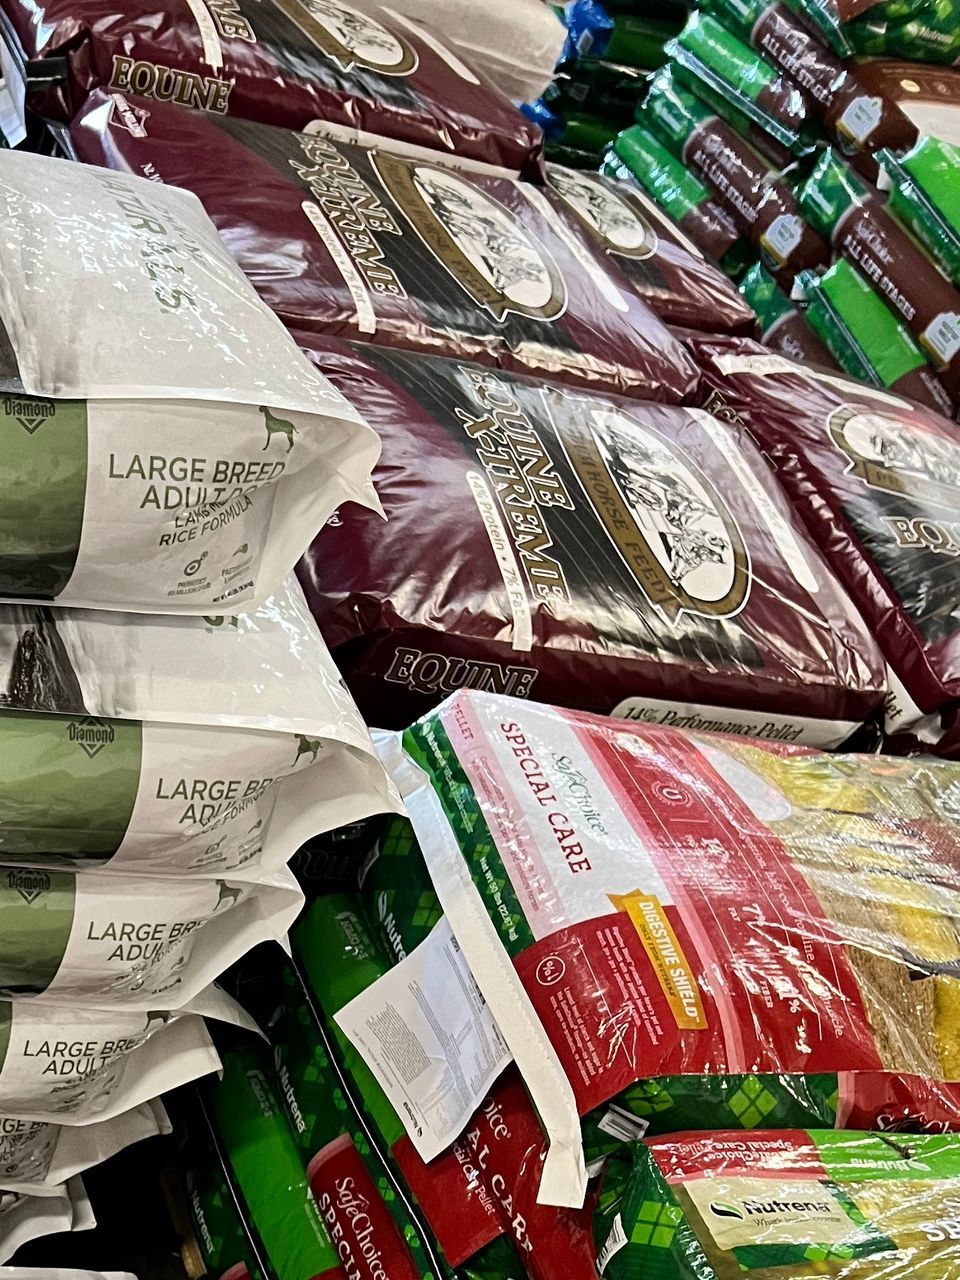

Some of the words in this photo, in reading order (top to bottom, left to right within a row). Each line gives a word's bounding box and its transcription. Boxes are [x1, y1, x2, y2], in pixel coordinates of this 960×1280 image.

[109, 54, 232, 115] EQUINE
[292, 131, 403, 235] EQUINE
[843, 236, 863, 261] ALL
[857, 252, 883, 284] LIFE
[880, 277, 916, 322] STAGES
[1, 397, 56, 419] Diamond
[458, 365, 575, 511] EQUINE
[109, 454, 207, 483] LARGE
[212, 460, 286, 484] BREED
[159, 527, 197, 547] RICE
[201, 494, 253, 536] FORMULA
[590, 475, 628, 530] HORSE
[626, 541, 670, 597] FEED
[484, 502, 505, 551] Protein
[513, 592, 525, 617] Fat
[388, 648, 539, 701] EQUINE
[67, 723, 114, 743] Diamond
[452, 703, 473, 741] PELLET
[660, 710, 756, 737] Performance
[757, 721, 804, 742] Pellet
[156, 778, 240, 801] LARGE
[501, 721, 557, 807] SPECIAL
[548, 812, 592, 873] CARE
[552, 752, 608, 835] SafeChoice
[7, 872, 51, 892] Diamond
[87, 921, 167, 942] LARGE
[639, 902, 680, 966] DIGESTIVE
[670, 967, 698, 1019] SHIELD
[760, 980, 772, 1009] FIBER
[23, 1040, 97, 1057] LARGE
[42, 1056, 110, 1075] ADULT
[279, 1065, 305, 1133] Nutrena
[476, 1185, 496, 1216] Pellet
[744, 1200, 832, 1216] Nutrena
[191, 1193, 214, 1254] Nutrena
